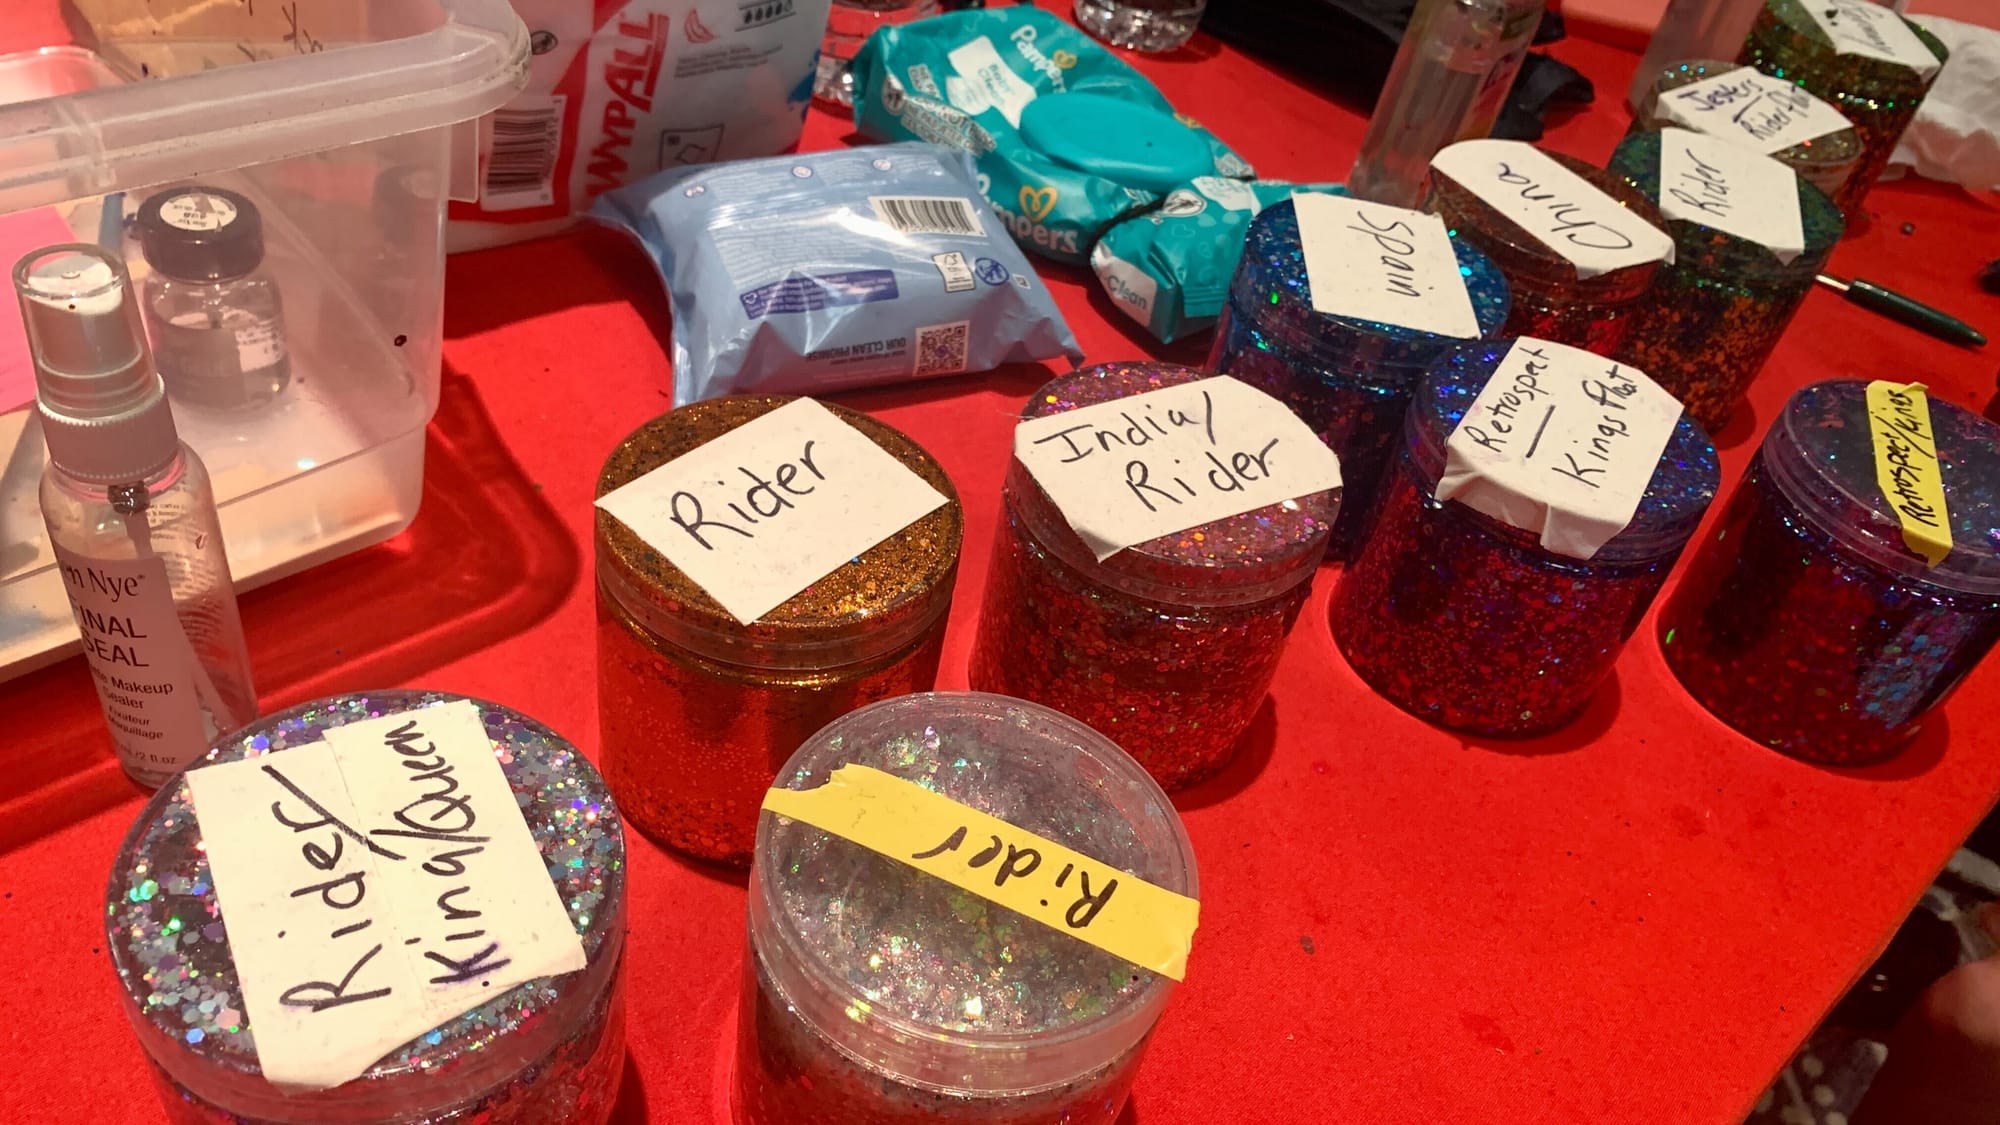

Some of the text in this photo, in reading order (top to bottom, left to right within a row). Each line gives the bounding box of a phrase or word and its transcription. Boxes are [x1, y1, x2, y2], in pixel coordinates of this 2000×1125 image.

[1010, 25, 1067, 93] Pampers
[1498, 162, 1633, 250] China
[1669, 148, 1733, 218] Rider
[1346, 210, 1434, 298] Spain
[1107, 275, 1148, 310] Clean
[851, 340, 884, 355] CLEAN
[1463, 346, 1551, 453] Retrospect
[1126, 438, 1280, 512] Rider
[1552, 415, 1631, 489] Kings
[670, 440, 826, 550] Rider
[73, 598, 147, 638] INAL
[111, 676, 174, 695] Makeup
[911, 825, 1118, 928] Rider
